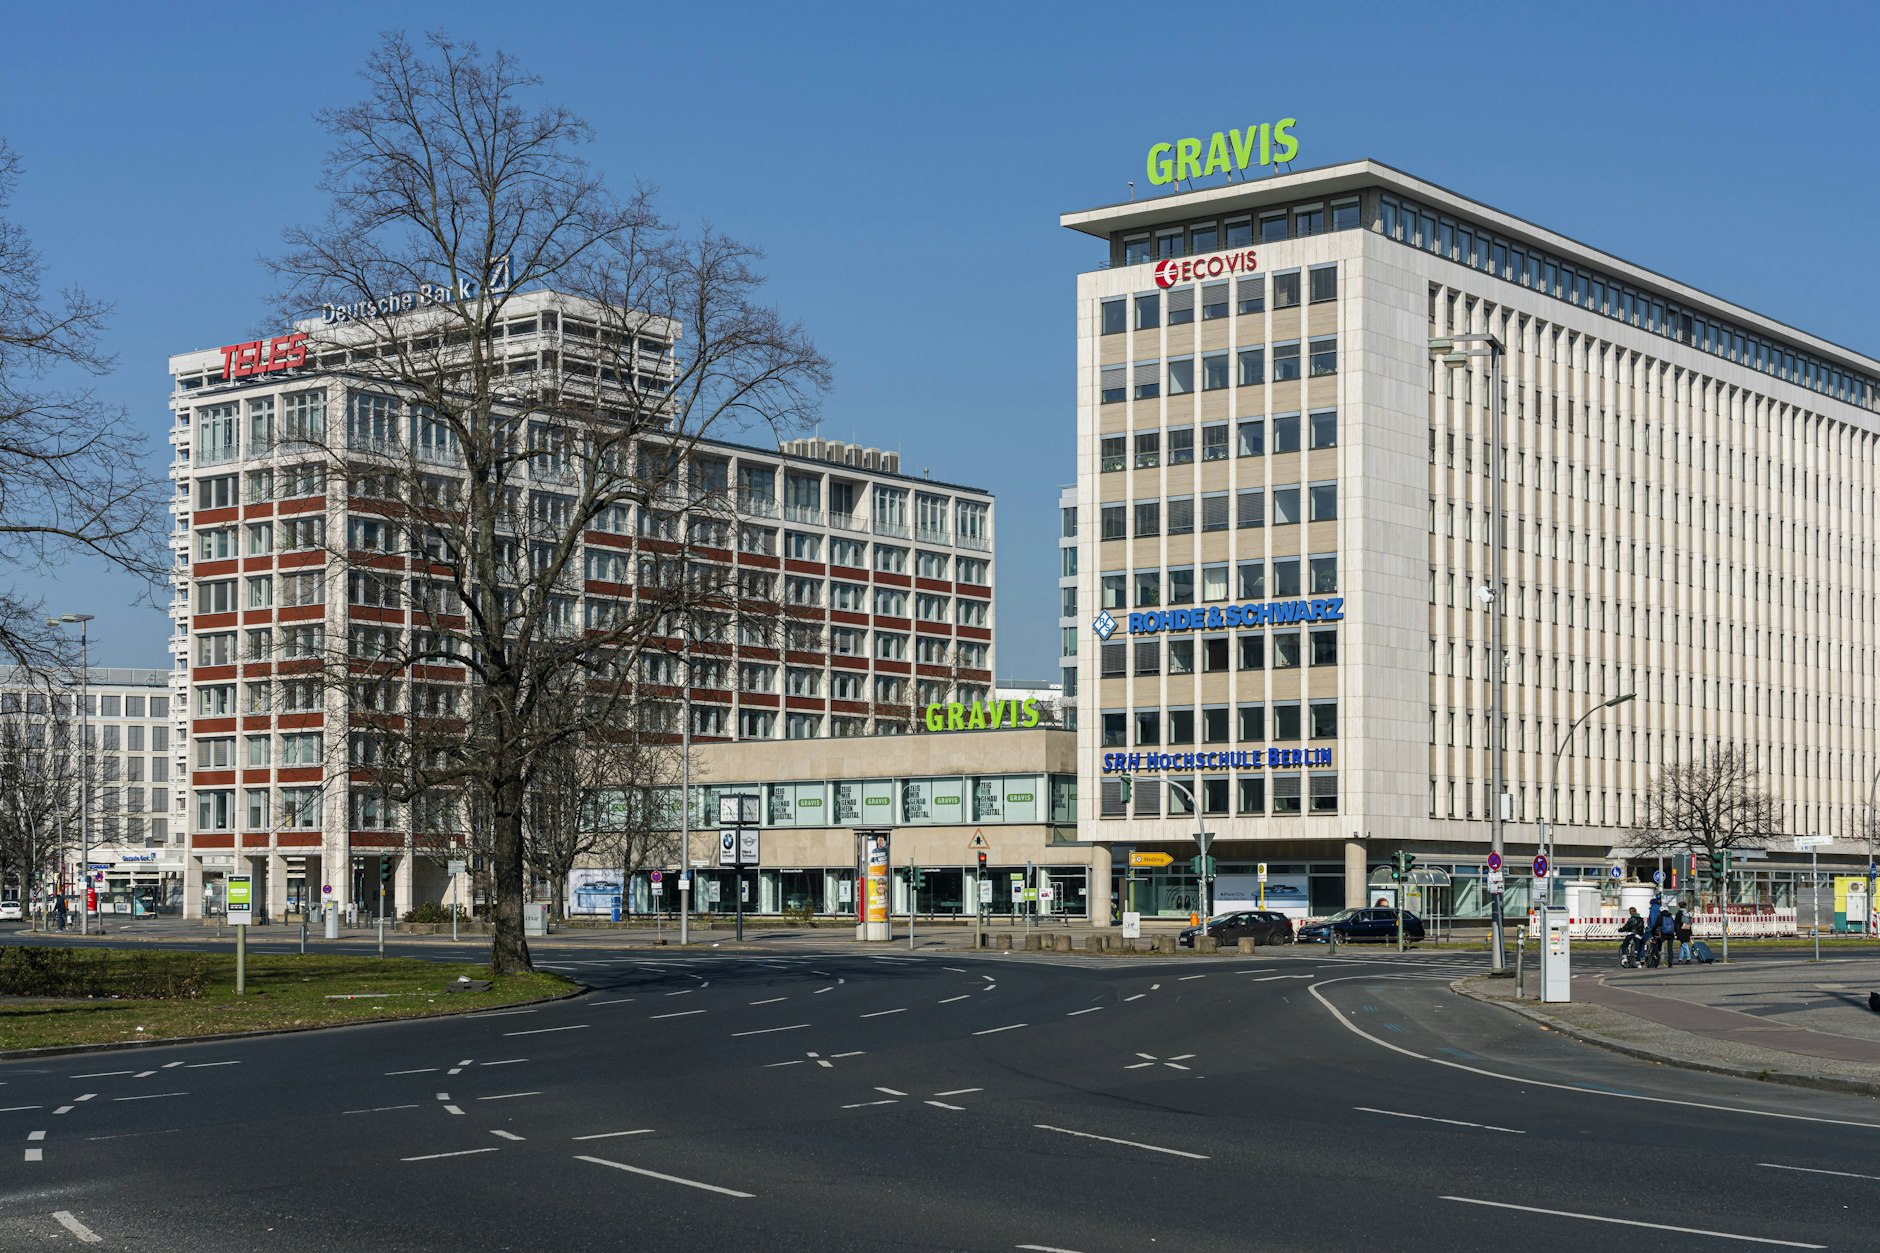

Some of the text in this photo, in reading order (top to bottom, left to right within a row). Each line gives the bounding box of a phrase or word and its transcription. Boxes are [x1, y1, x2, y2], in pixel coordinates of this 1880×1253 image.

[1147, 117, 1299, 186] GRAVIS
[1181, 250, 1257, 281] ECOVIS
[321, 292, 415, 324] Deutsche
[220, 332, 309, 380] TELES
[1128, 597, 1345, 635] ROHDE & SCHWARZ
[925, 697, 1040, 732] GRAVIS
[1103, 747, 1333, 773] SRH HOCHSCHULE BERLIN
